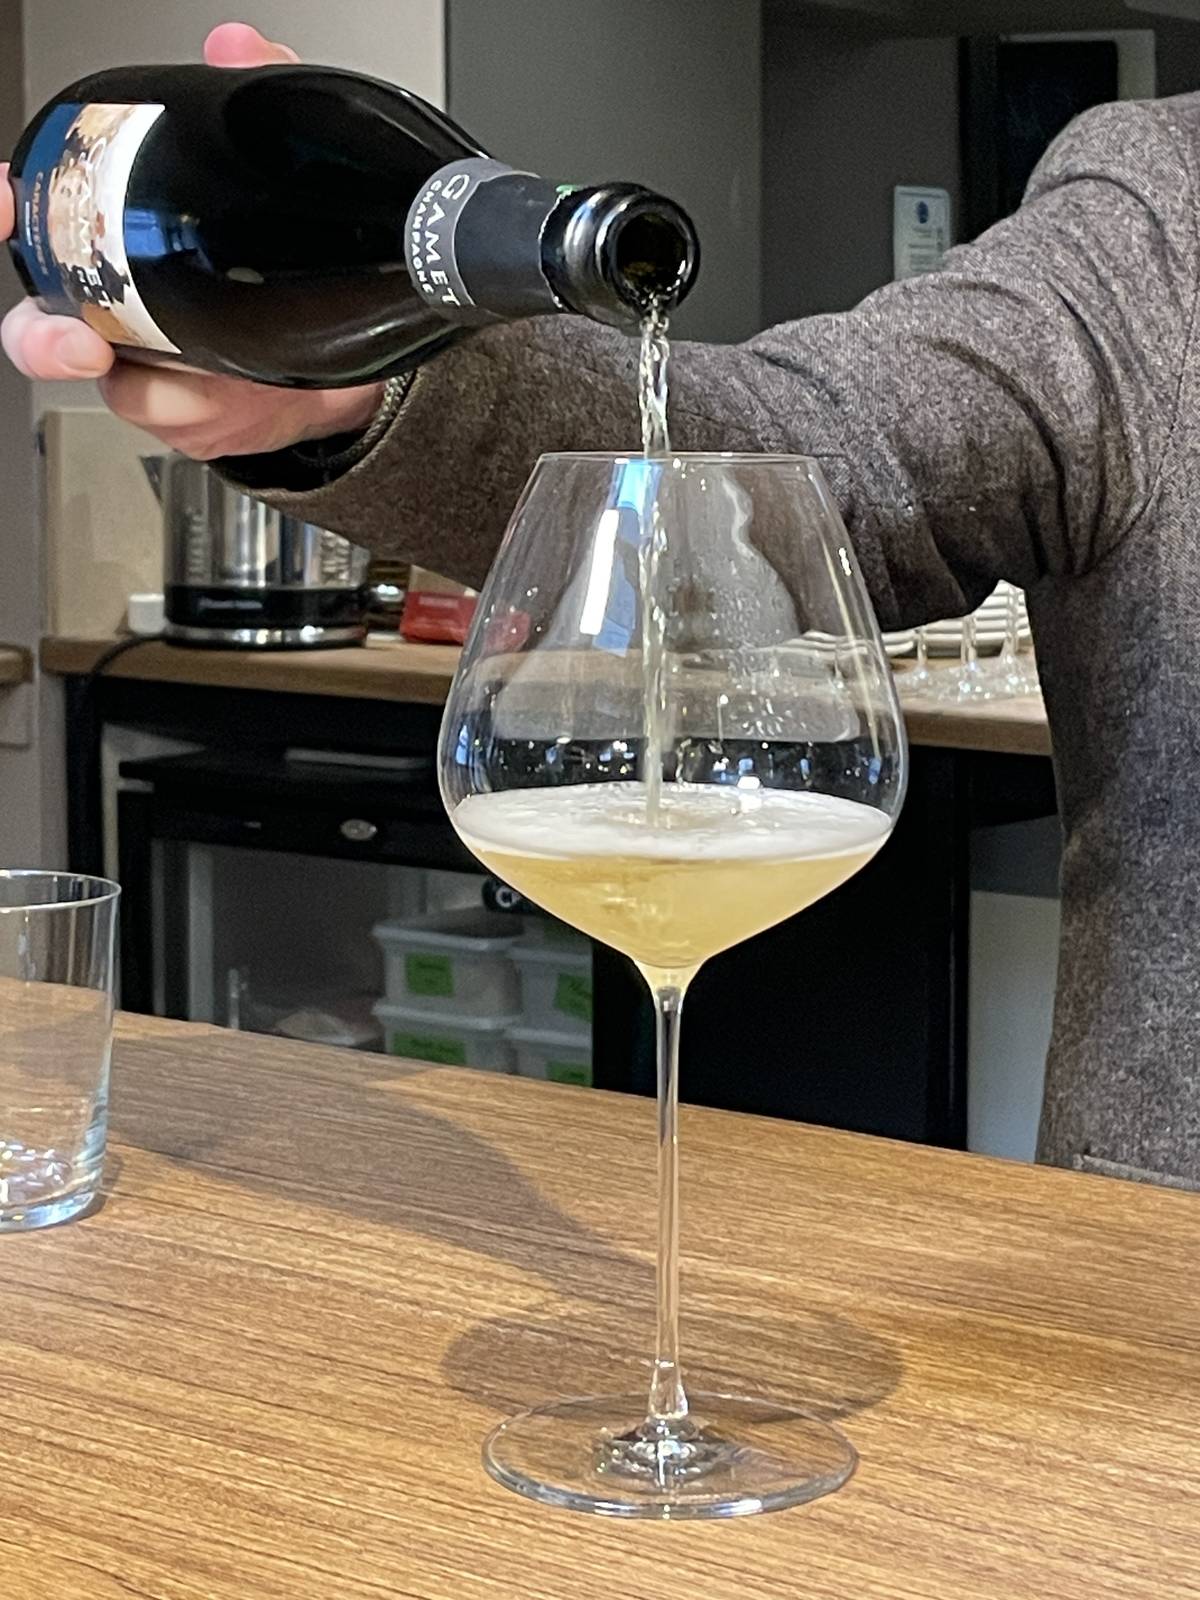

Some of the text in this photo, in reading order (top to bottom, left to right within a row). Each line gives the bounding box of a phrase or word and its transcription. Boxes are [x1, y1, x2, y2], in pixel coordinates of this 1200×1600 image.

[79, 137, 111, 308] GAMET
[411, 179, 442, 294] CHAMPAGNE
[425, 174, 470, 306] GAMET
